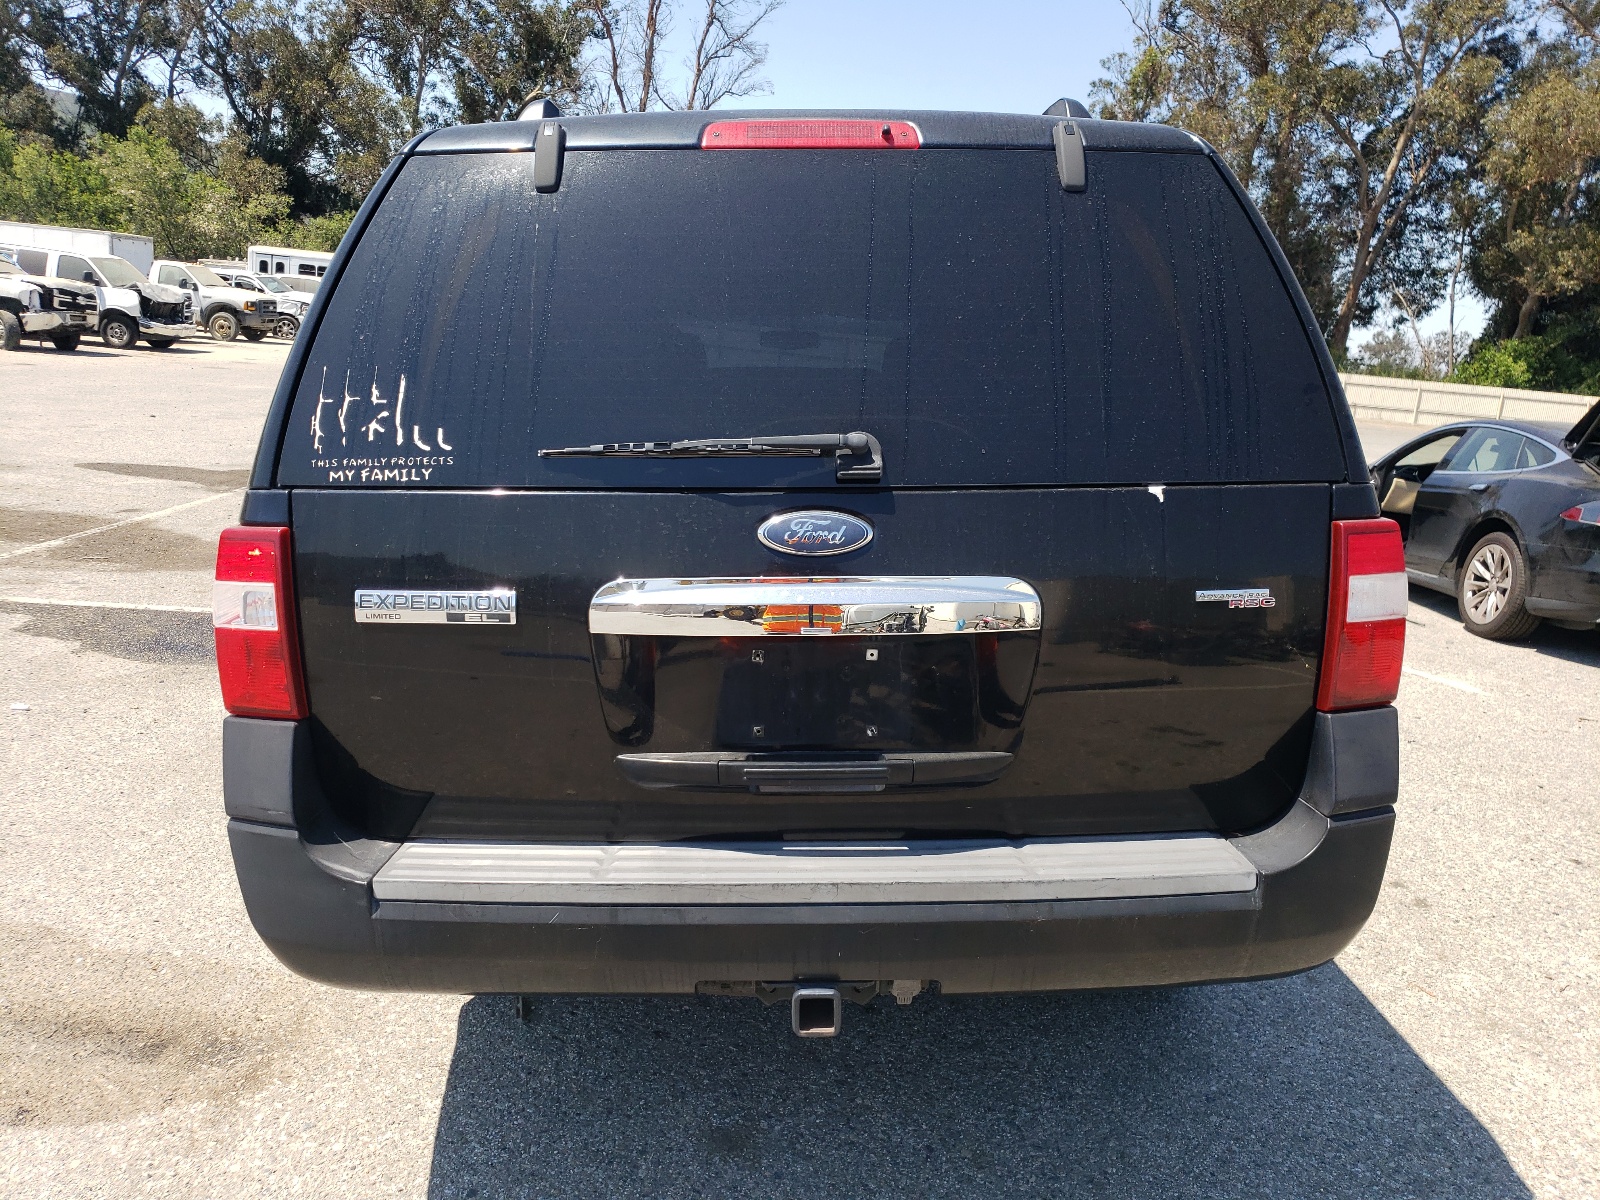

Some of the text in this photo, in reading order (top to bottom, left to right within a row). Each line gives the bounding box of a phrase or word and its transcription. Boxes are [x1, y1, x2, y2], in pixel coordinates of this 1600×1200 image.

[311, 456, 454, 468] THIS FAMILY PROTECTS
[329, 468, 433, 482] MY FAMILY
[784, 518, 847, 545] Ford
[358, 593, 512, 612] EXPEDITION
[1228, 597, 1276, 608] RSC
[464, 614, 500, 622] EL
